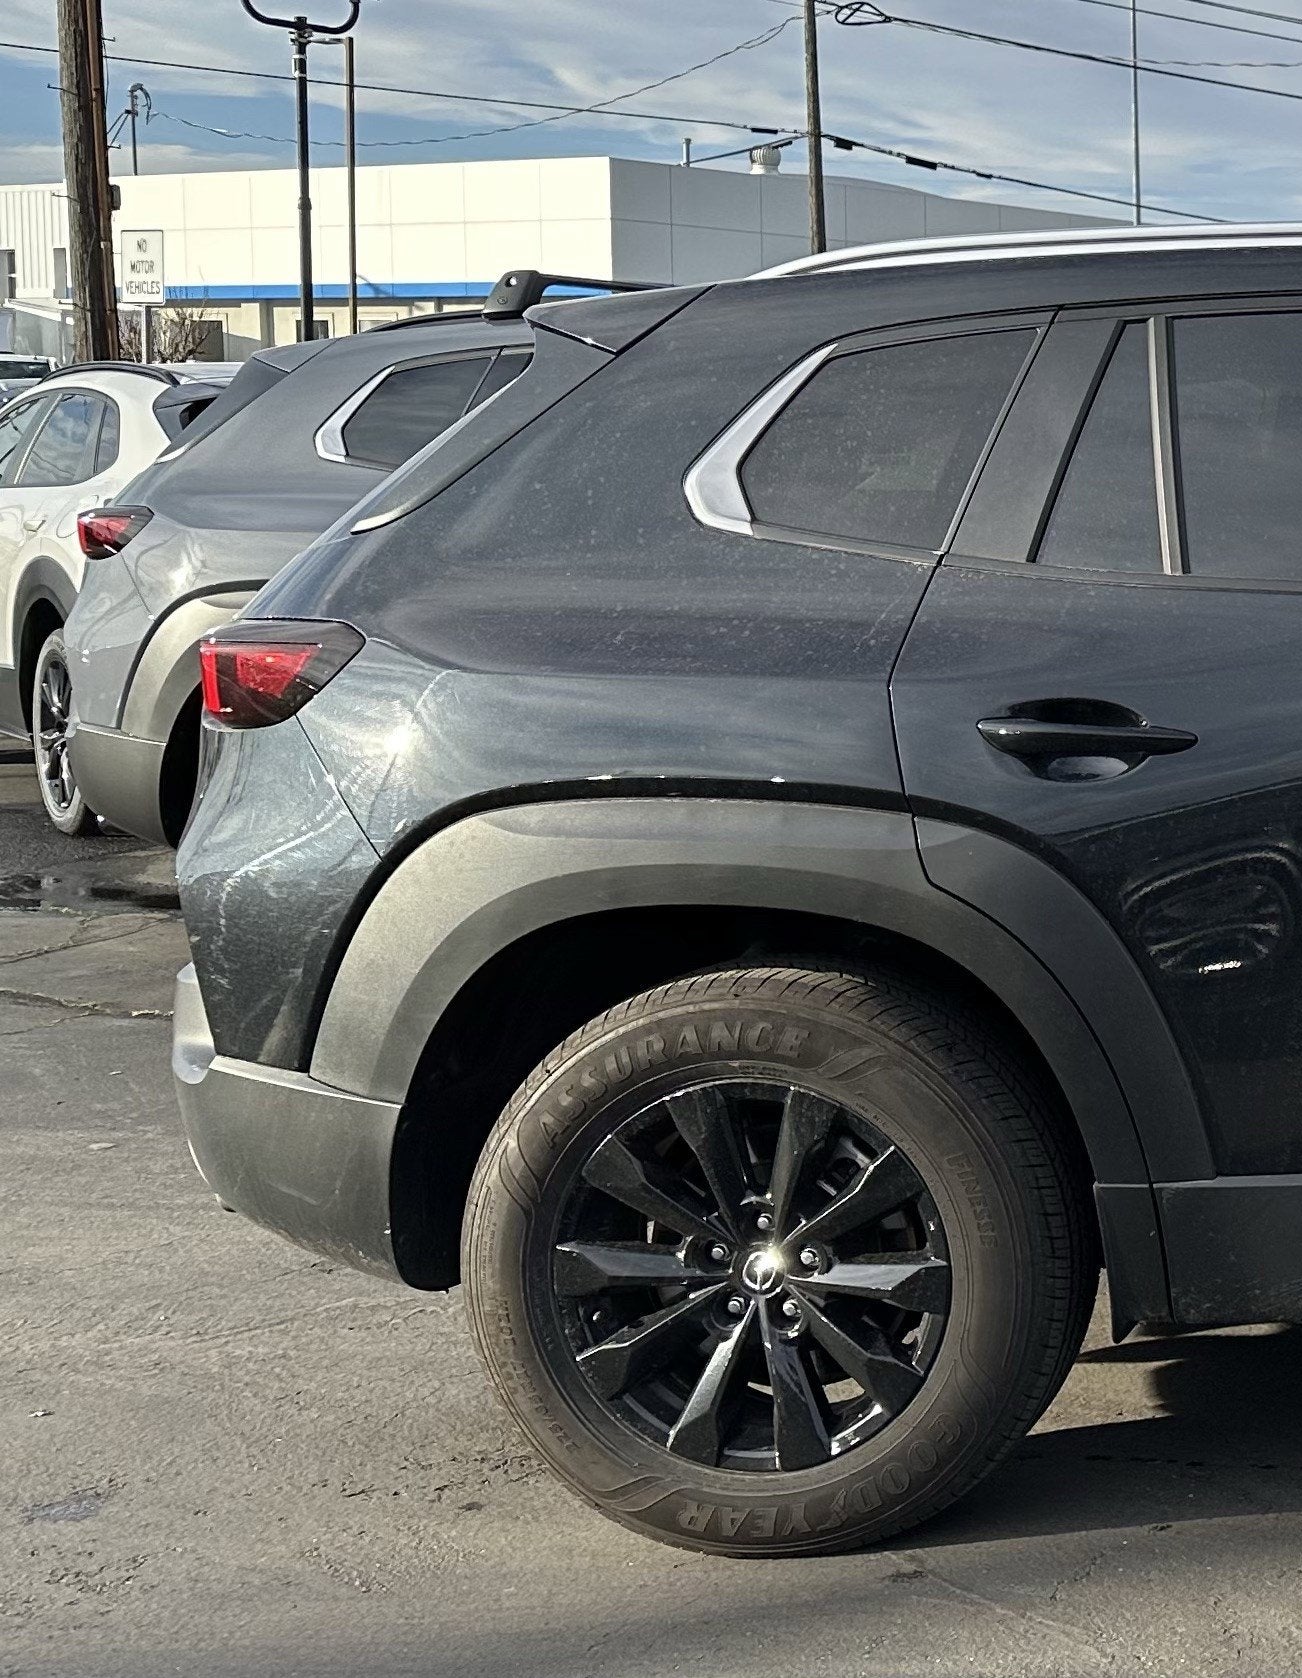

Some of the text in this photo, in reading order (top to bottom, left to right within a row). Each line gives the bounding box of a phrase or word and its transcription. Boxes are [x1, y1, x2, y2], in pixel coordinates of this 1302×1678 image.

[137, 238, 147, 253] NO
[130, 260, 154, 274] MOTOR
[125, 280, 160, 294] VEHICLES
[540, 1019, 811, 1149] ASSURANCE
[677, 1411, 963, 1538] GOODYEAR
